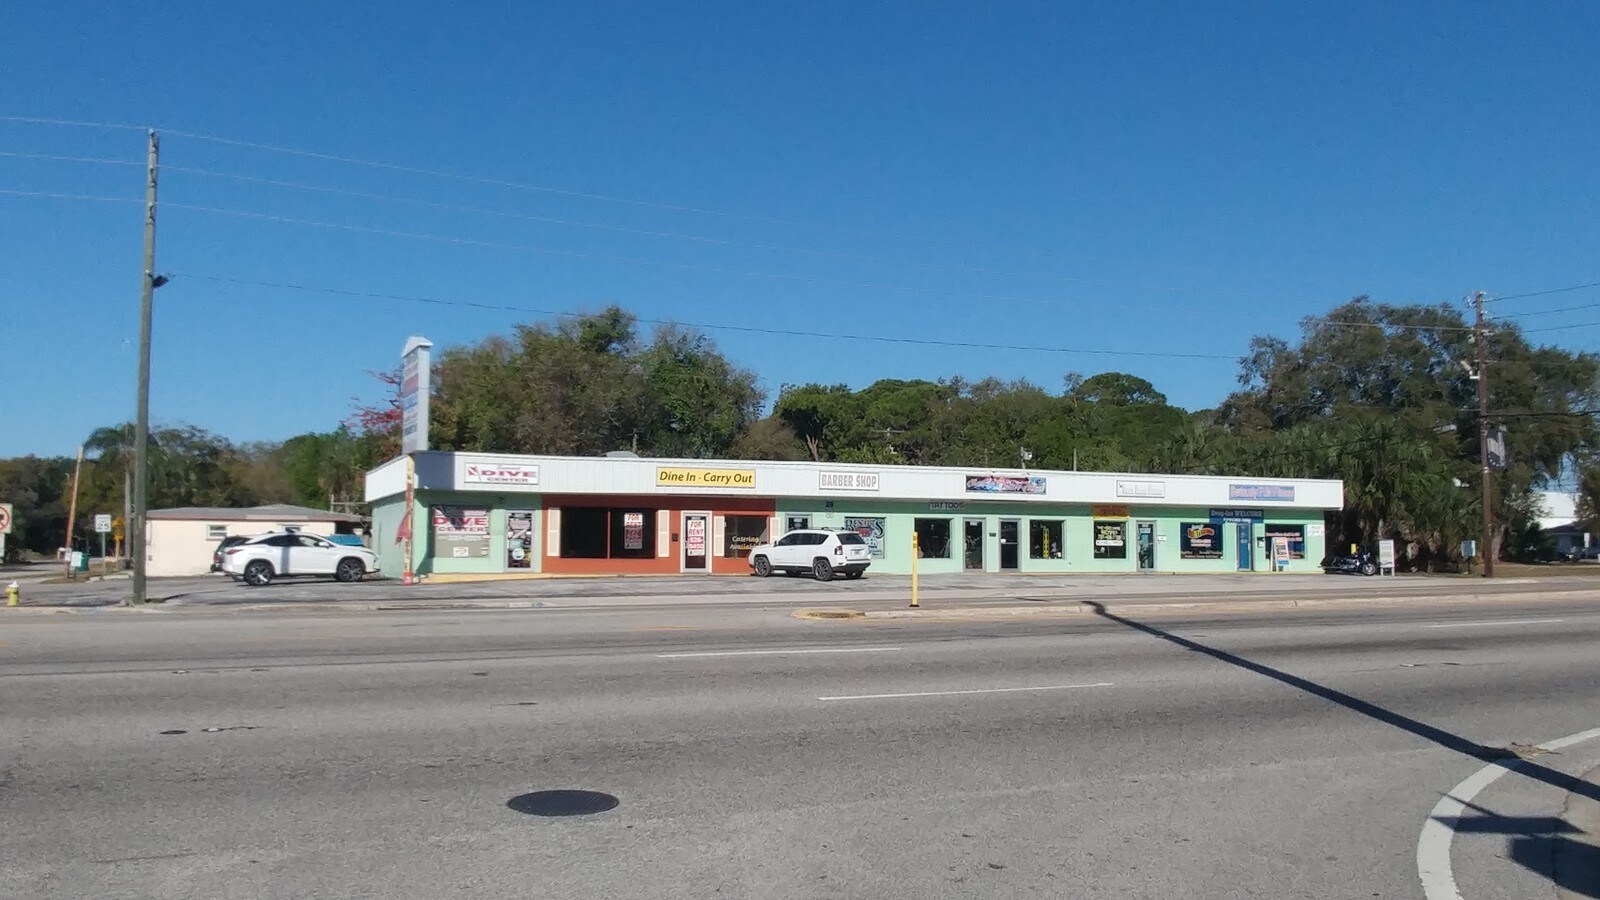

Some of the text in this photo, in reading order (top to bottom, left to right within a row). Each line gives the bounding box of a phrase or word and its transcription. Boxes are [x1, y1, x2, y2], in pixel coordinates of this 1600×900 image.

[481, 470, 537, 478] DIVE
[660, 471, 684, 481] Dine
[686, 472, 696, 482] In
[703, 473, 732, 485] Carry
[734, 474, 753, 483] Out
[821, 474, 877, 488] BARBER SHOP
[930, 501, 965, 509] TATTOOS
[433, 516, 487, 526] DIVE
[688, 528, 704, 536] RENT
[732, 535, 759, 543] Catering
